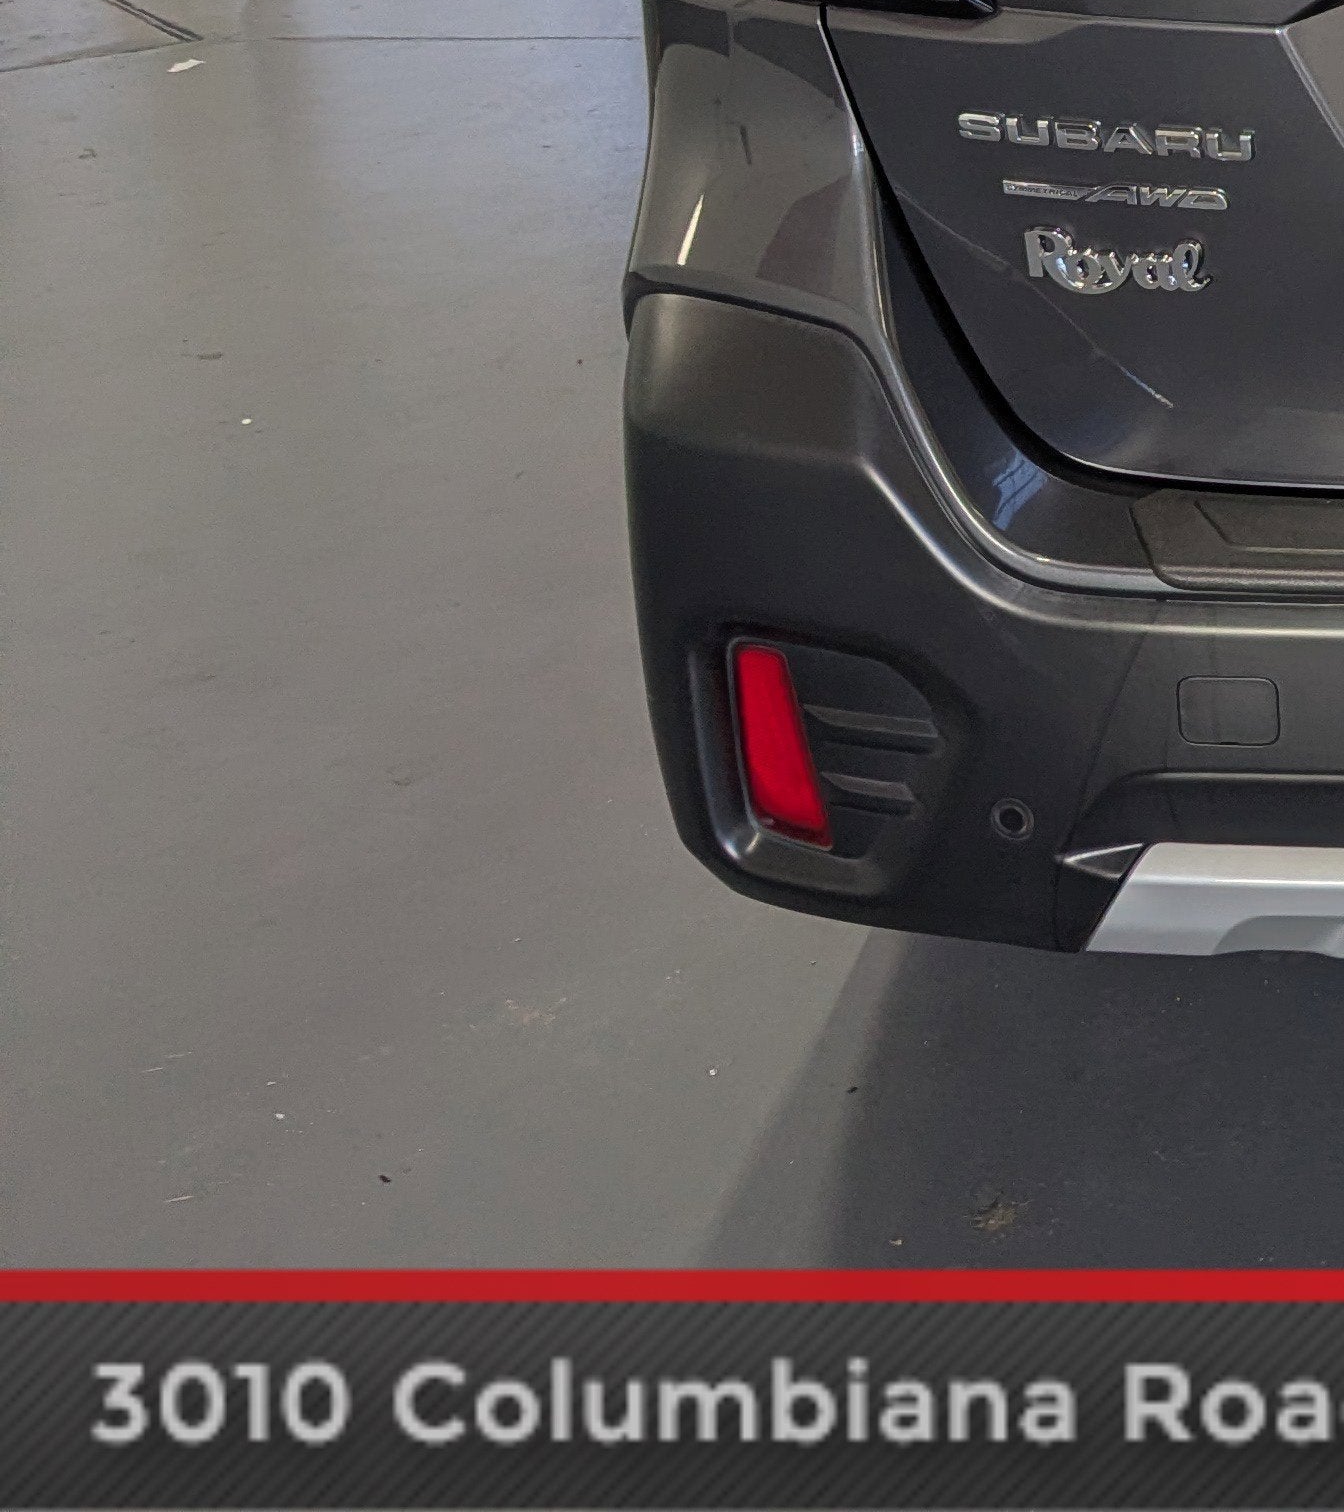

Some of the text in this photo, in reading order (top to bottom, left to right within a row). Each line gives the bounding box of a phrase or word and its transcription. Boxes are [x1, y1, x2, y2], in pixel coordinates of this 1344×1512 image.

[957, 112, 1256, 161] SUBARU
[1085, 184, 1229, 209] AWD
[1024, 226, 1211, 294] Royal
